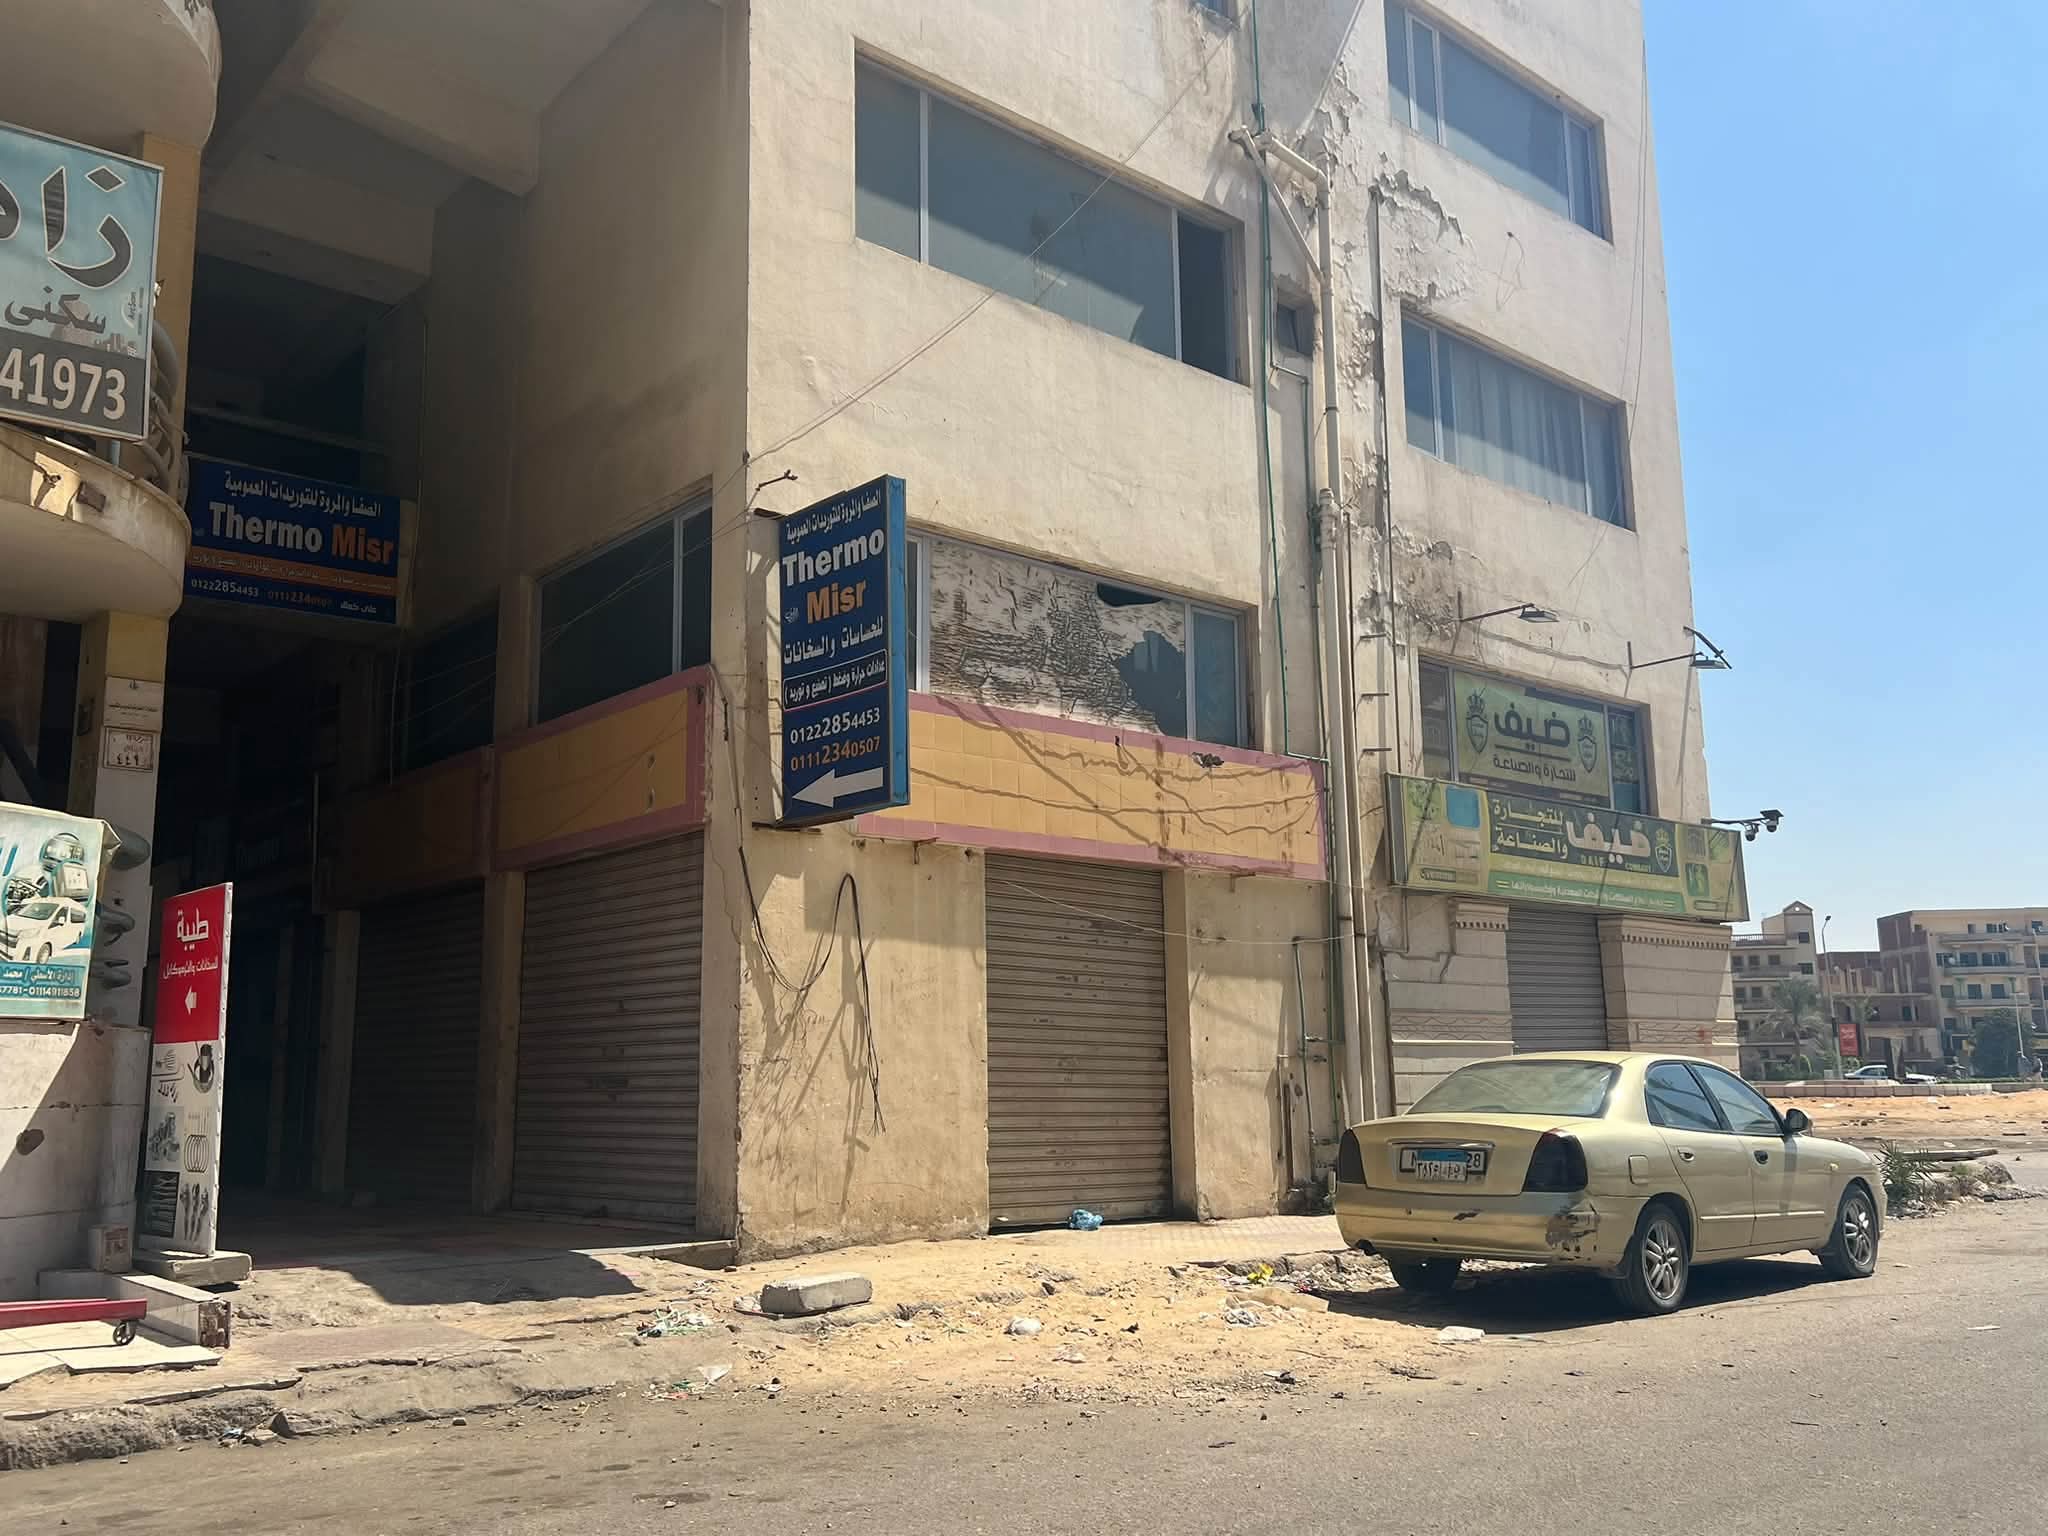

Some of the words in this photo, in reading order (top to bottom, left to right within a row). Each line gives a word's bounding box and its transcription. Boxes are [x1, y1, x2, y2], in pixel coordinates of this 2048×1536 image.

[0, 348, 127, 421] 41973
[209, 501, 323, 553] Thermo
[331, 523, 394, 565] Misr
[782, 528, 885, 587] Thermo
[807, 580, 867, 624] Misr
[790, 707, 881, 744] 01222854453
[1493, 701, 1571, 751] ضيف
[791, 736, 881, 772] 01112340507
[1566, 812, 1651, 865] ضيف
[176, 907, 209, 951] طيبة
